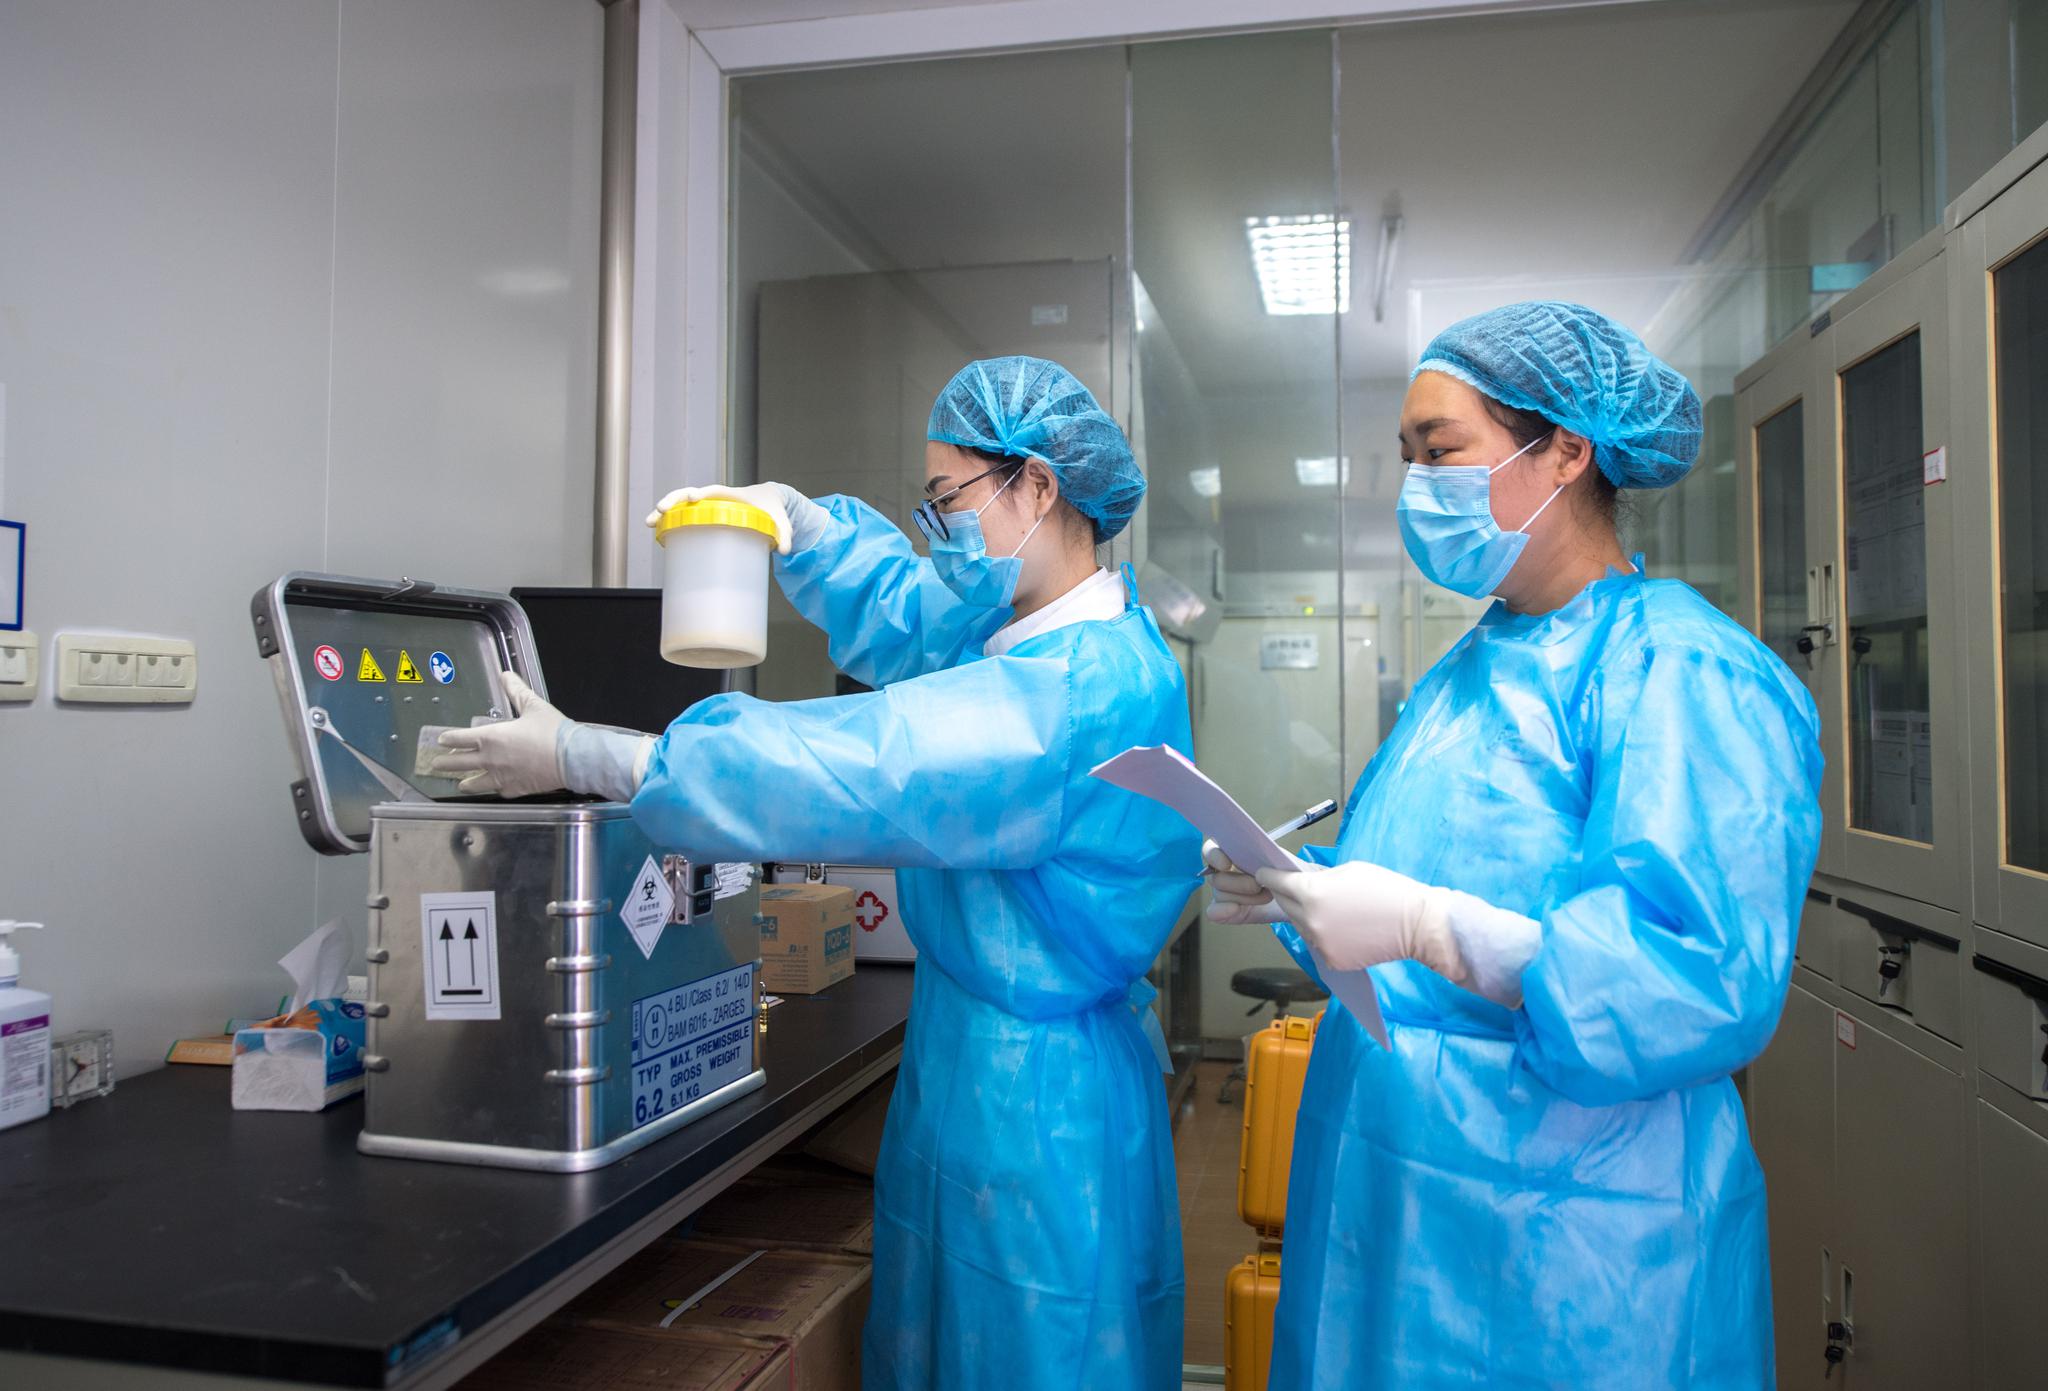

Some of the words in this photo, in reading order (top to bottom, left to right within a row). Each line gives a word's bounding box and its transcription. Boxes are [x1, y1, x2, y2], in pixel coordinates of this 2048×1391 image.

[668, 998, 673, 1015] 4
[668, 1021, 687, 1042] BAM
[688, 1013, 708, 1034] 6016
[713, 998, 745, 1025] ZARGES
[670, 1050, 693, 1069] MAX.
[696, 1025, 750, 1058] PREMISSIBLE
[638, 1063, 661, 1087] TYP
[671, 1063, 702, 1088] GROSS
[709, 1046, 741, 1071] WEIGHT
[636, 1088, 664, 1123] 6.2
[671, 1092, 684, 1107] 6.1
[686, 1083, 700, 1100] KG
